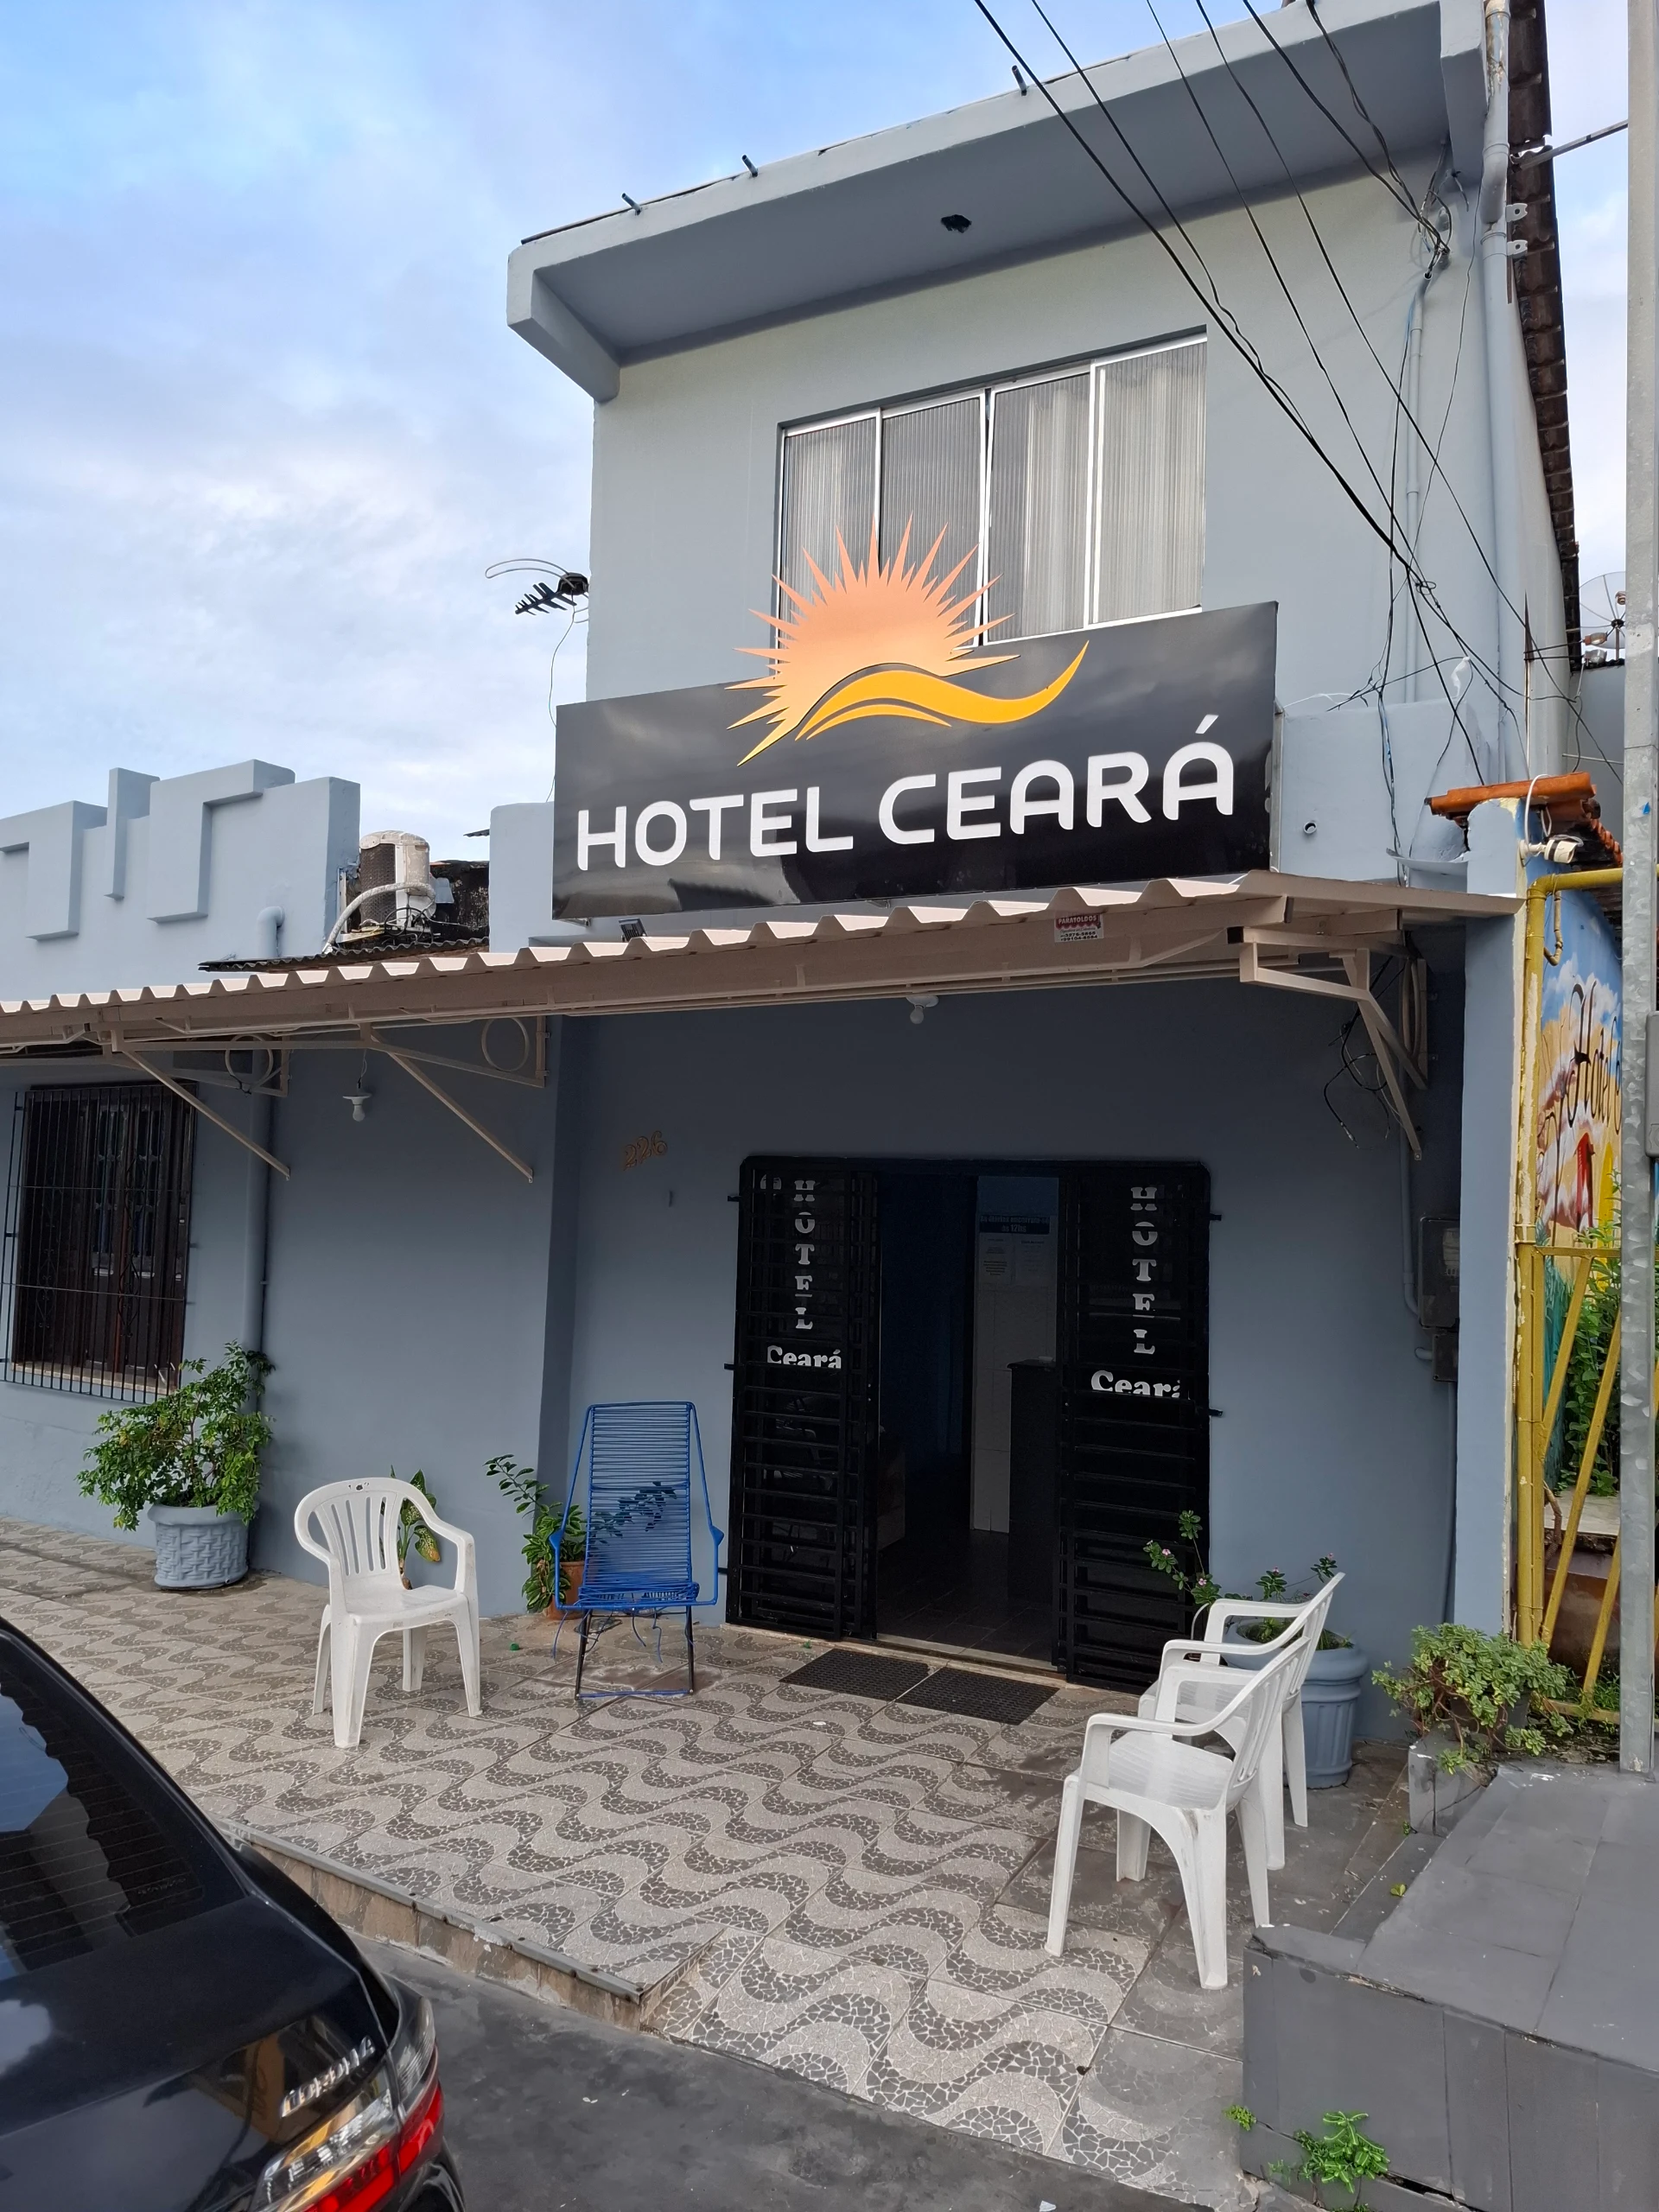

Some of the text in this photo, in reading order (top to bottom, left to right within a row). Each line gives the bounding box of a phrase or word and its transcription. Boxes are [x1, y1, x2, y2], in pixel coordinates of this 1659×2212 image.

[577, 714, 1235, 871] HOTEL CEARÁ
[1058, 915, 1097, 925] PARATOLDOS
[623, 1130, 669, 1171] 226
[767, 1344, 842, 1370] Ceará
